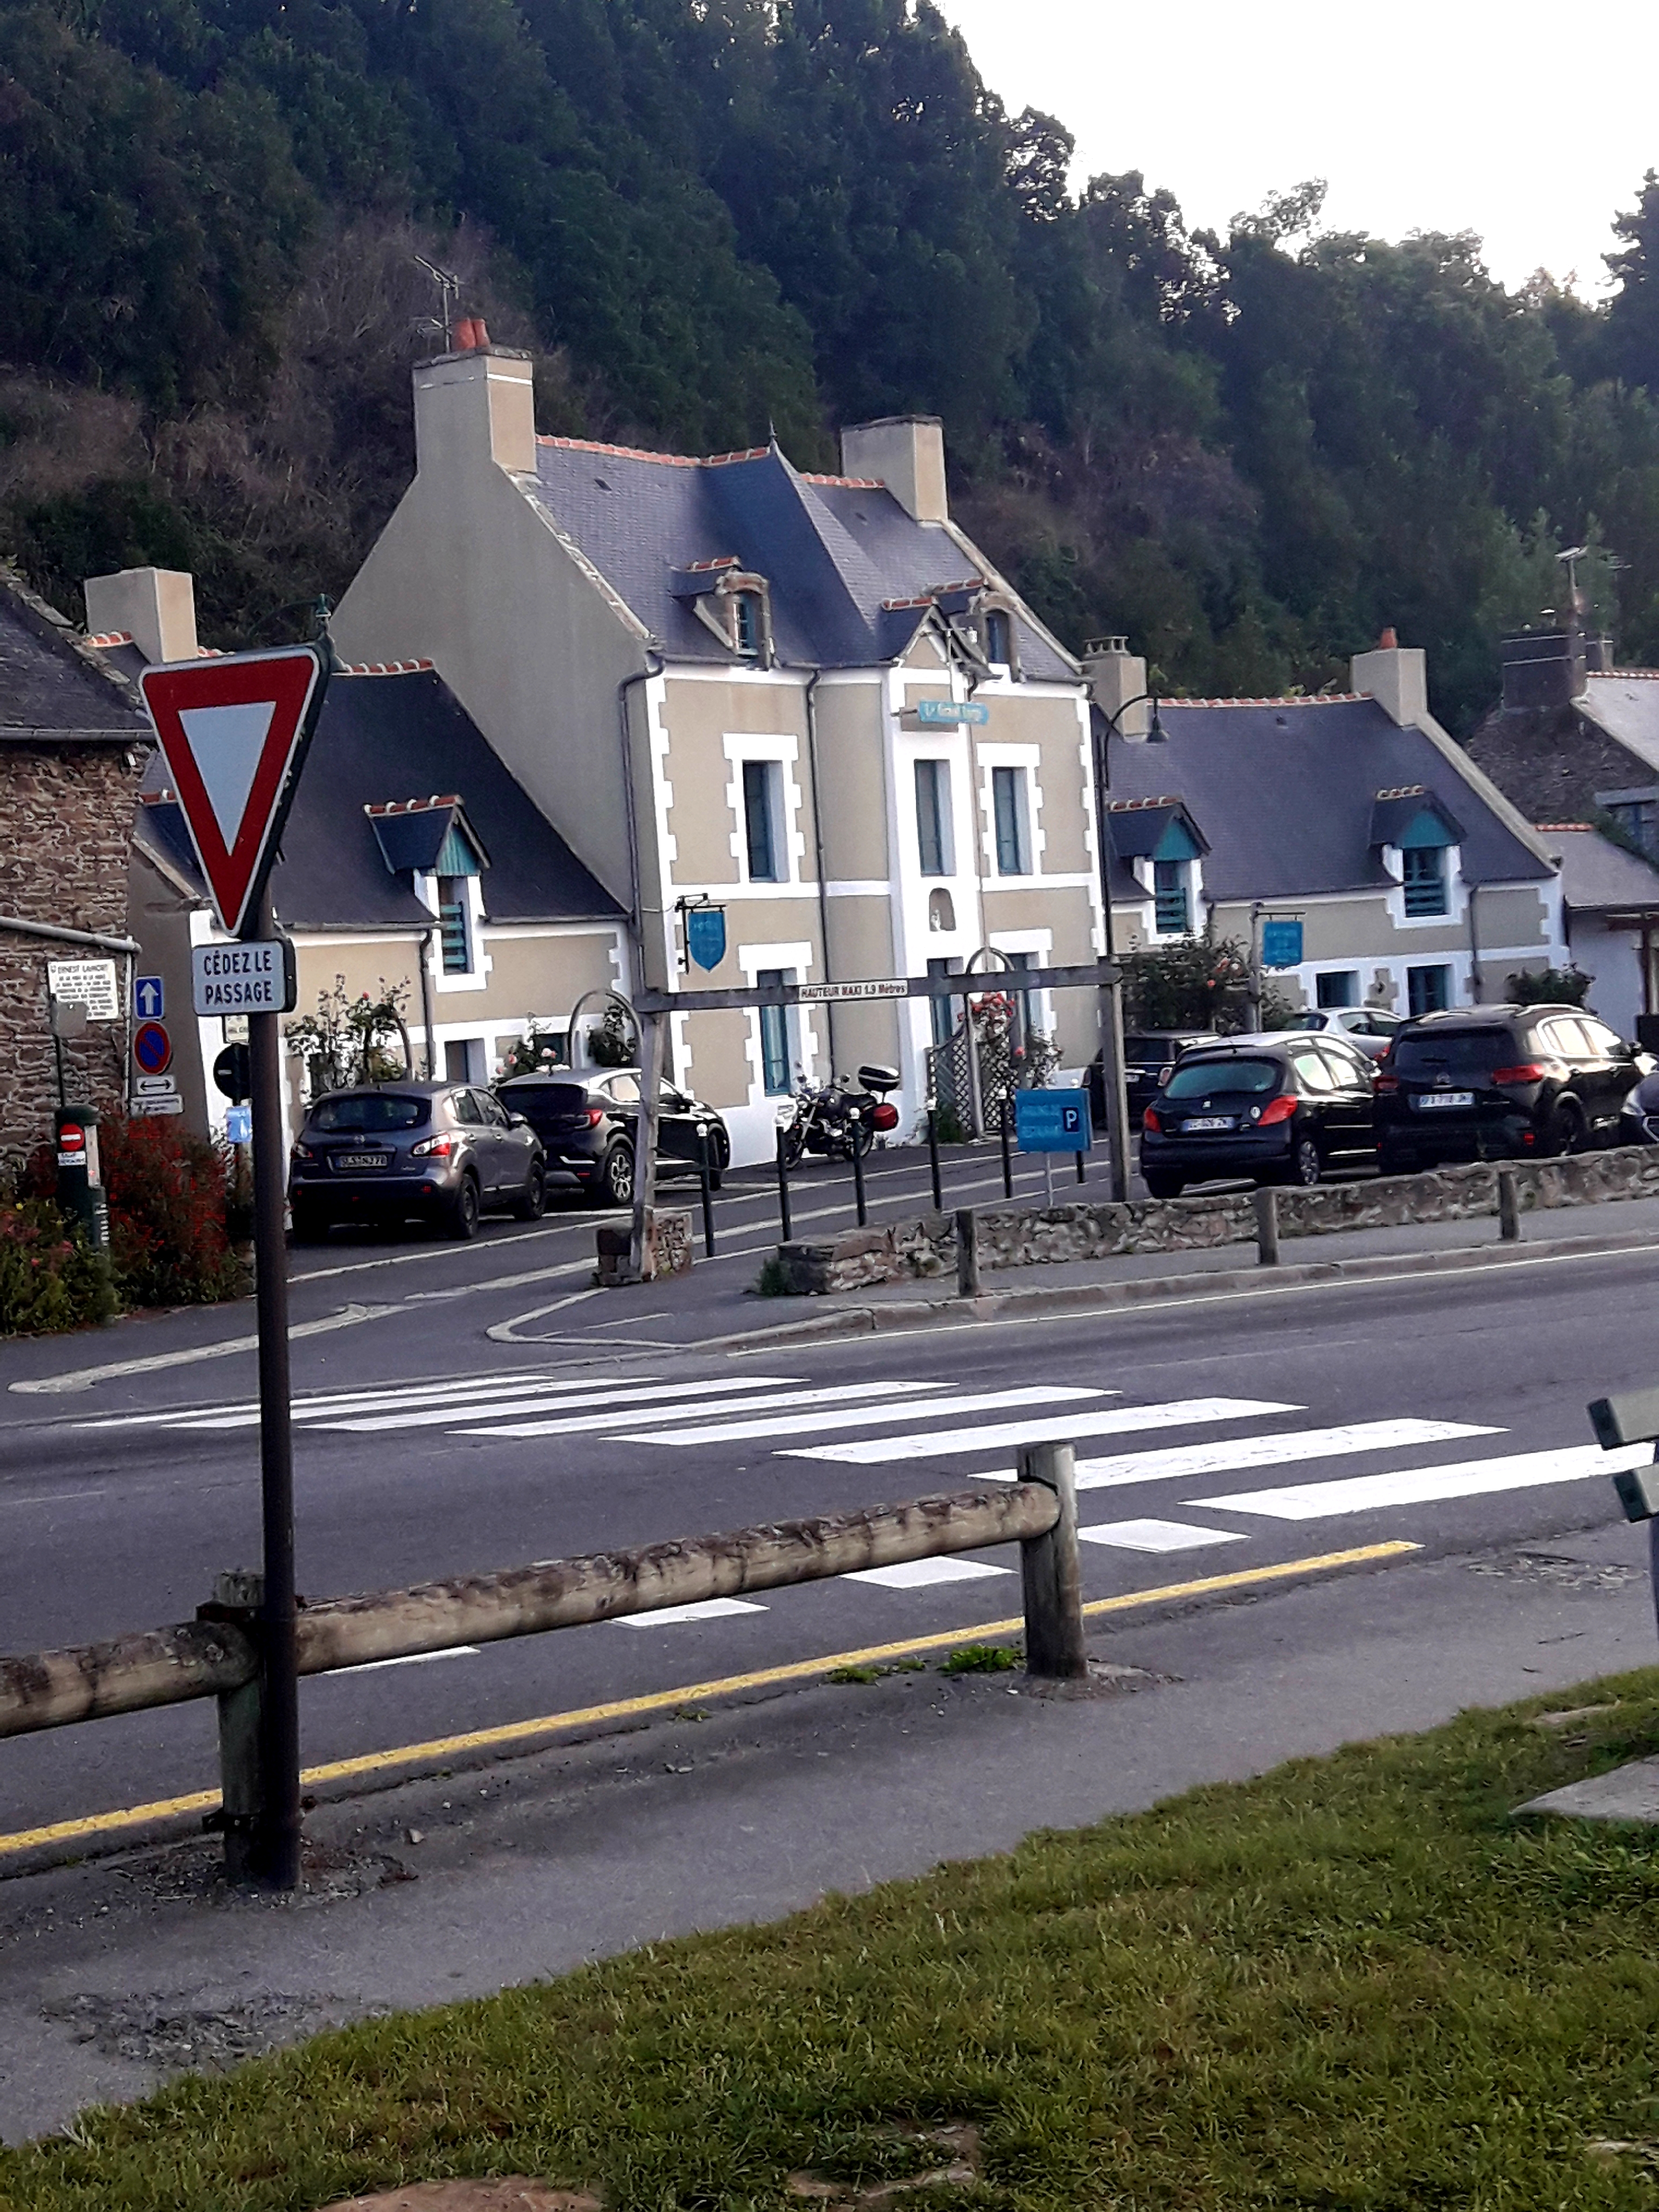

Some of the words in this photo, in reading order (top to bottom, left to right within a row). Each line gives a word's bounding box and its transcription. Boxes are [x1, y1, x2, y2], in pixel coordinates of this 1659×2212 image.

[204, 949, 251, 976] CÉDEZ
[255, 950, 272, 972] LE
[205, 980, 273, 1005] PASSAGE
[801, 987, 839, 998] HAUTEUR
[841, 985, 862, 996] MAXI
[1065, 1109, 1077, 1129] P
